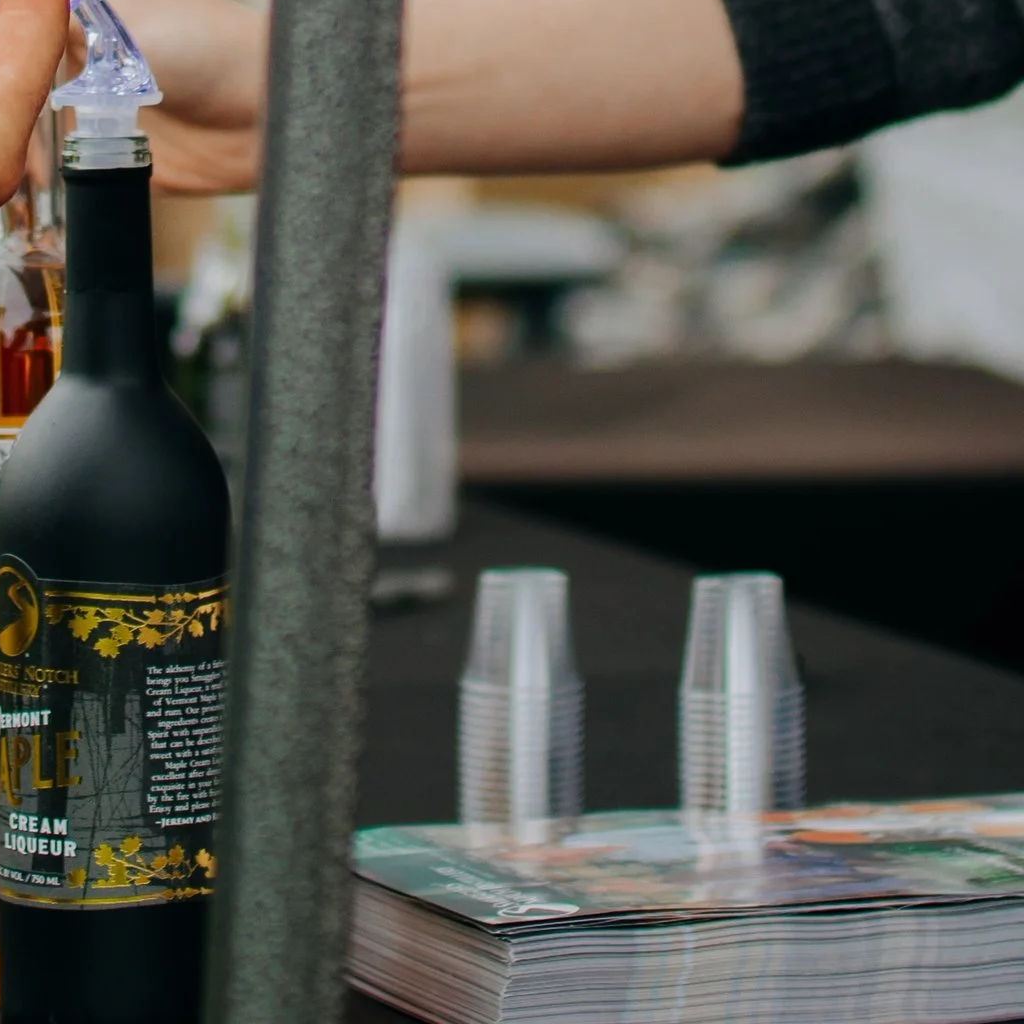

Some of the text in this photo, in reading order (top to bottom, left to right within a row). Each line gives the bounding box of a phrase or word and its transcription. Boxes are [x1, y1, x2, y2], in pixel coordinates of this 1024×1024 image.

[24, 665, 79, 685] NOTCH
[146, 665, 163, 675] The
[174, 677, 190, 686] you
[146, 688, 173, 696] Cream
[153, 696, 162, 706] of
[164, 696, 198, 706] Vermont
[146, 707, 162, 717] and
[185, 706, 200, 715] Our
[172, 727, 190, 737] with
[151, 740, 167, 749] that
[169, 740, 184, 748] can
[185, 737, 195, 746] be
[149, 752, 172, 760] sweet
[175, 748, 193, 758] with
[164, 759, 188, 771] Maple
[189, 759, 211, 767] Cream
[151, 771, 186, 781] excellent
[147, 793, 158, 804] by
[161, 792, 174, 801] the
[149, 804, 172, 815] Enjoy
[174, 801, 189, 812] and
[8, 812, 68, 836] CREAM
[195, 814, 212, 824] AND
[4, 833, 77, 857] LIQUEUR
[31, 874, 45, 885] 750
